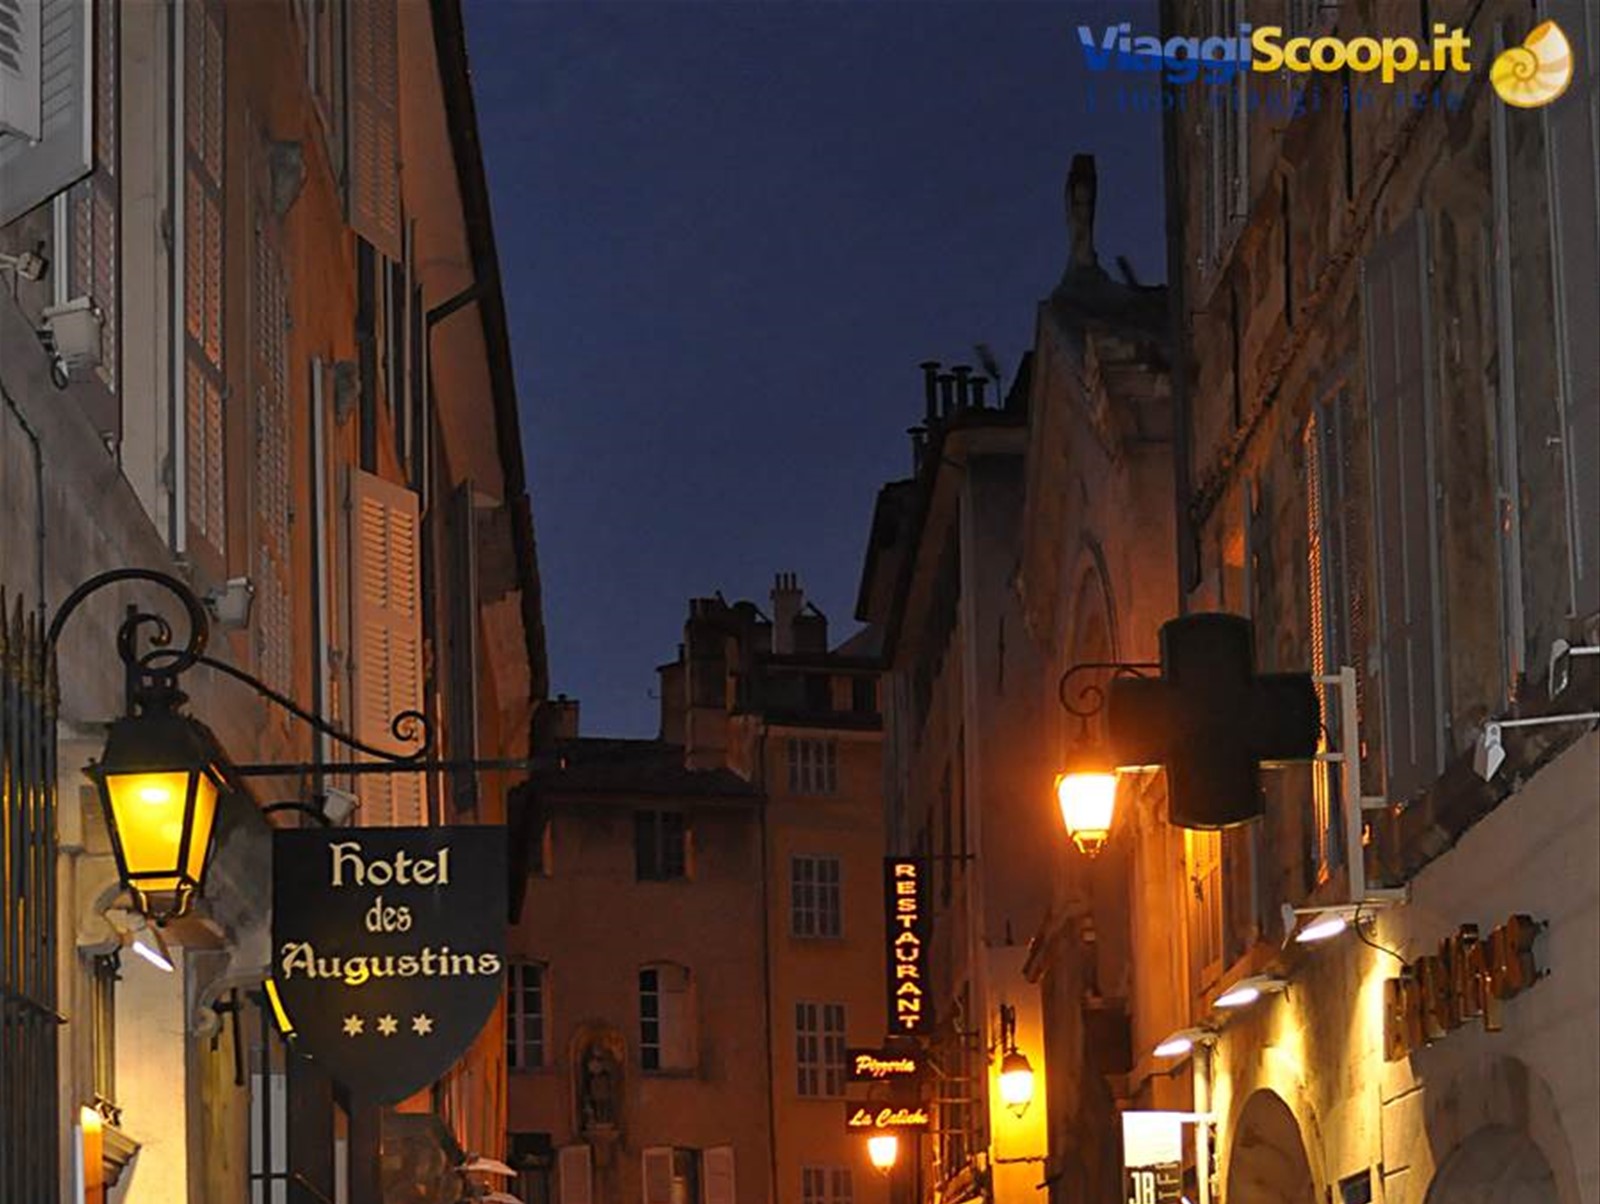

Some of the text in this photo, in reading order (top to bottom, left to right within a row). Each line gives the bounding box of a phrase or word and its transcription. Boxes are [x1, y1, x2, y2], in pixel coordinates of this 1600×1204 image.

[365, 895, 412, 932] des
[281, 941, 501, 986] Augustins
[894, 863, 923, 1029] RESTAURANT
